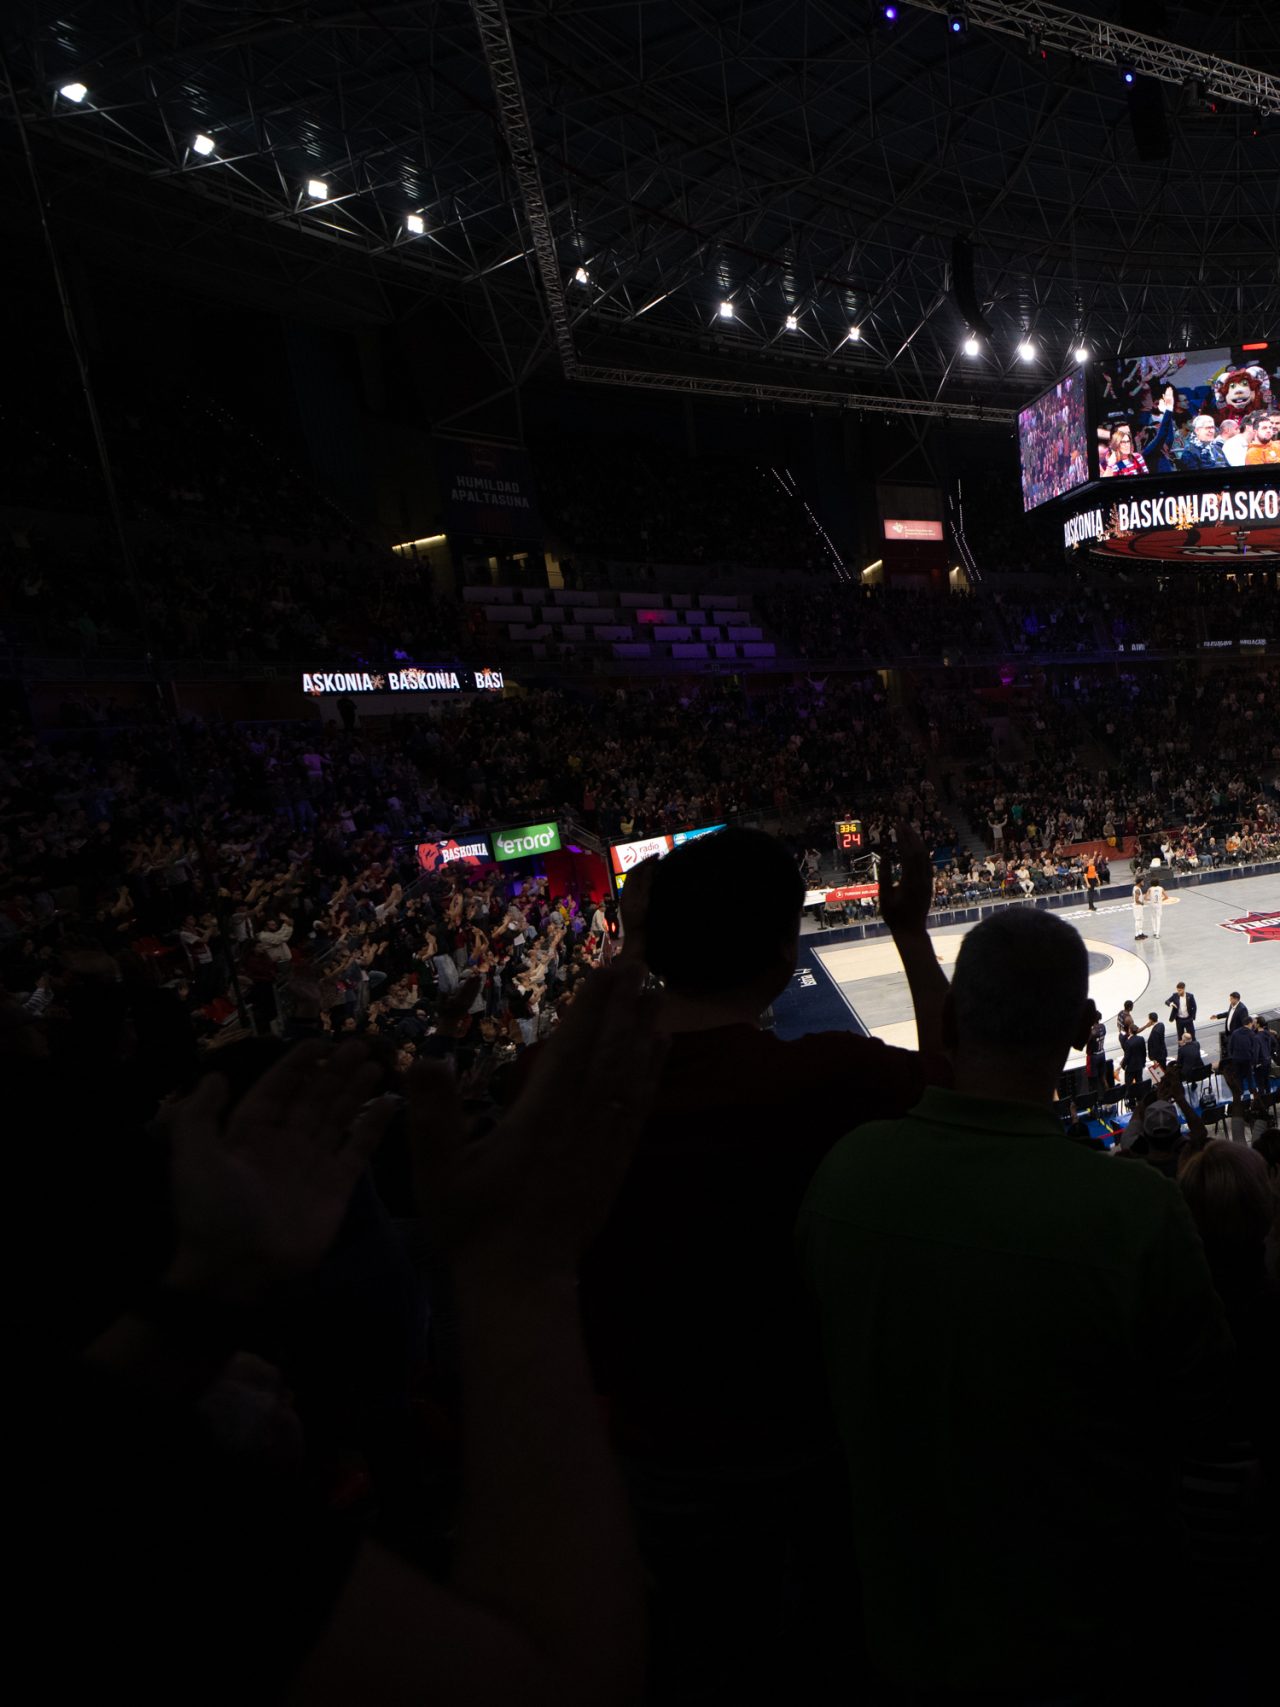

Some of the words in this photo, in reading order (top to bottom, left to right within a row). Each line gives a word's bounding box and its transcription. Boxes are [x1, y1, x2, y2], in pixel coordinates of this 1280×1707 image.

[456, 475, 520, 494] HUMILDAD
[451, 488, 530, 509] APALTASUNA
[1119, 493, 1213, 531] BASKONIA
[388, 671, 460, 690] BASKONIA
[639, 842, 660, 853] radio
[843, 834, 861, 848] 24
[441, 843, 489, 863] BASKONIA
